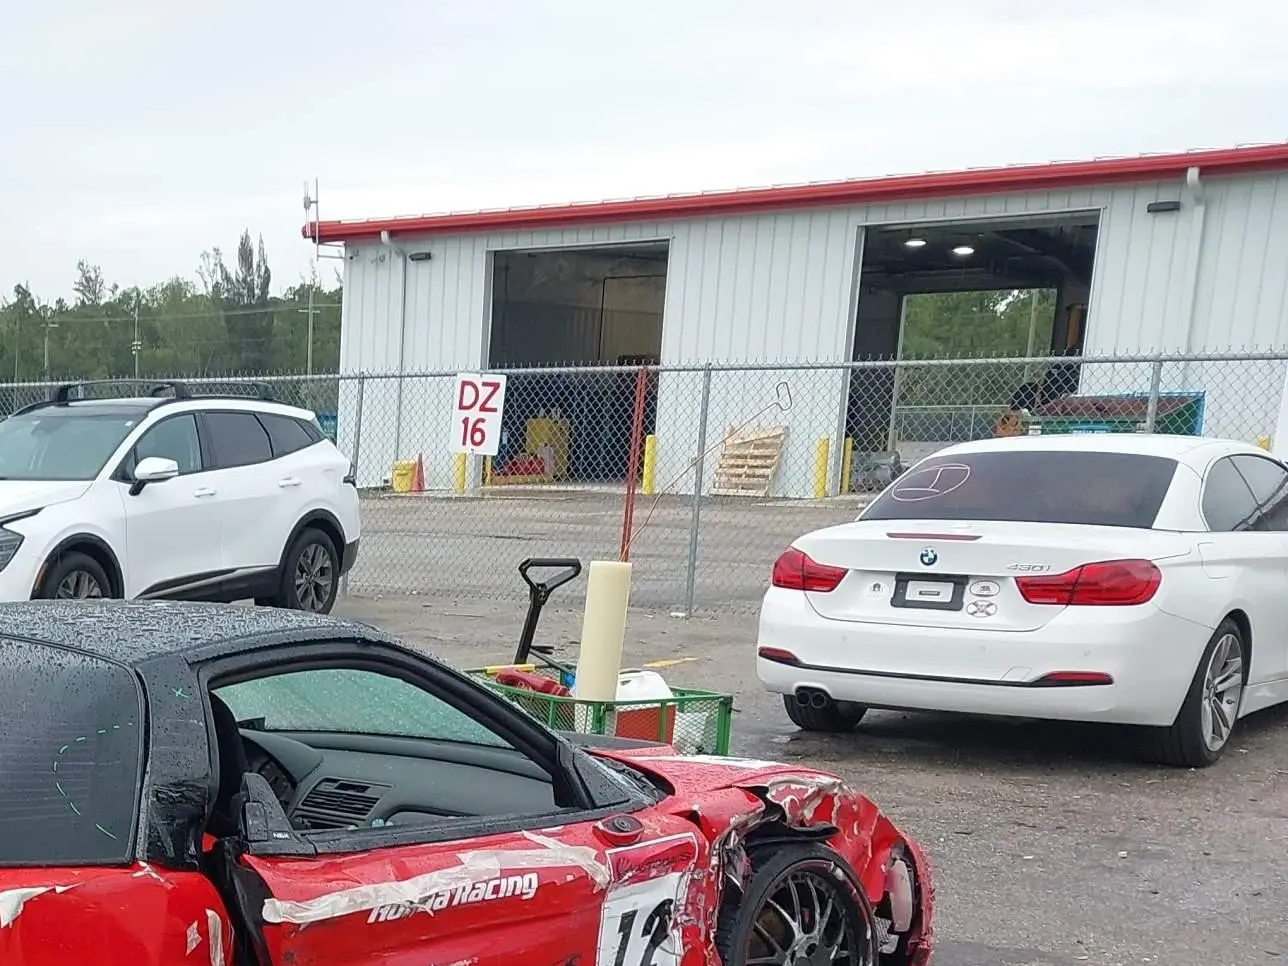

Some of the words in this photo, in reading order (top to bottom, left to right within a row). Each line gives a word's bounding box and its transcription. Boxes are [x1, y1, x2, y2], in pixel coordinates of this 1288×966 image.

[457, 380, 501, 413] DZ
[461, 416, 487, 447] 16
[452, 872, 539, 904] Racing
